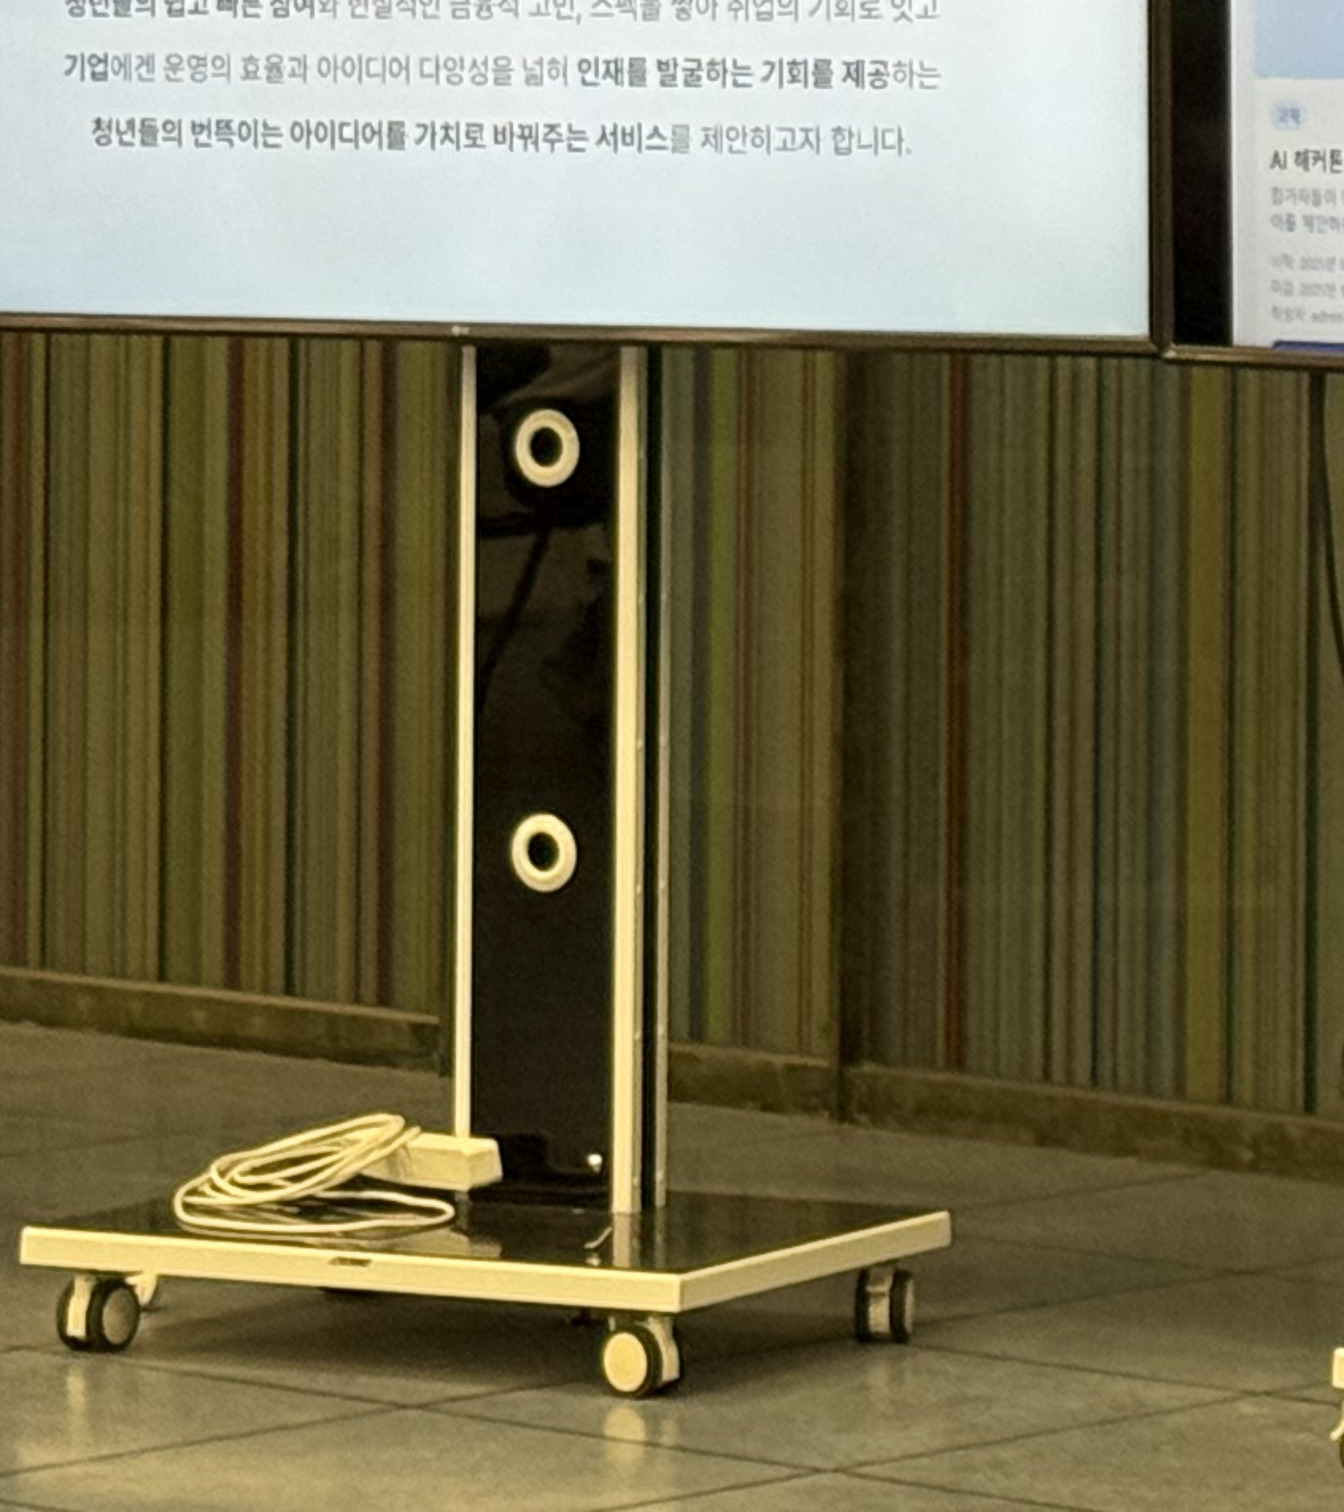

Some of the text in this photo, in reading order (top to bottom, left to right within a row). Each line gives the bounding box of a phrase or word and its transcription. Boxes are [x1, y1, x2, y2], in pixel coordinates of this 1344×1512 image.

[63, 51, 940, 90] 기업에겐 운영의 효율과 아이디어 다양성을 넓혀 인재를 발굴하는 기회를 제공하는
[91, 116, 912, 158] 청년들의 번뜩이는 아이디어를 가치로 바꿔주는 서비스를 제안하고자 합니다.
[1270, 150, 1288, 171] AI
[1294, 148, 1343, 175] 해커톤
